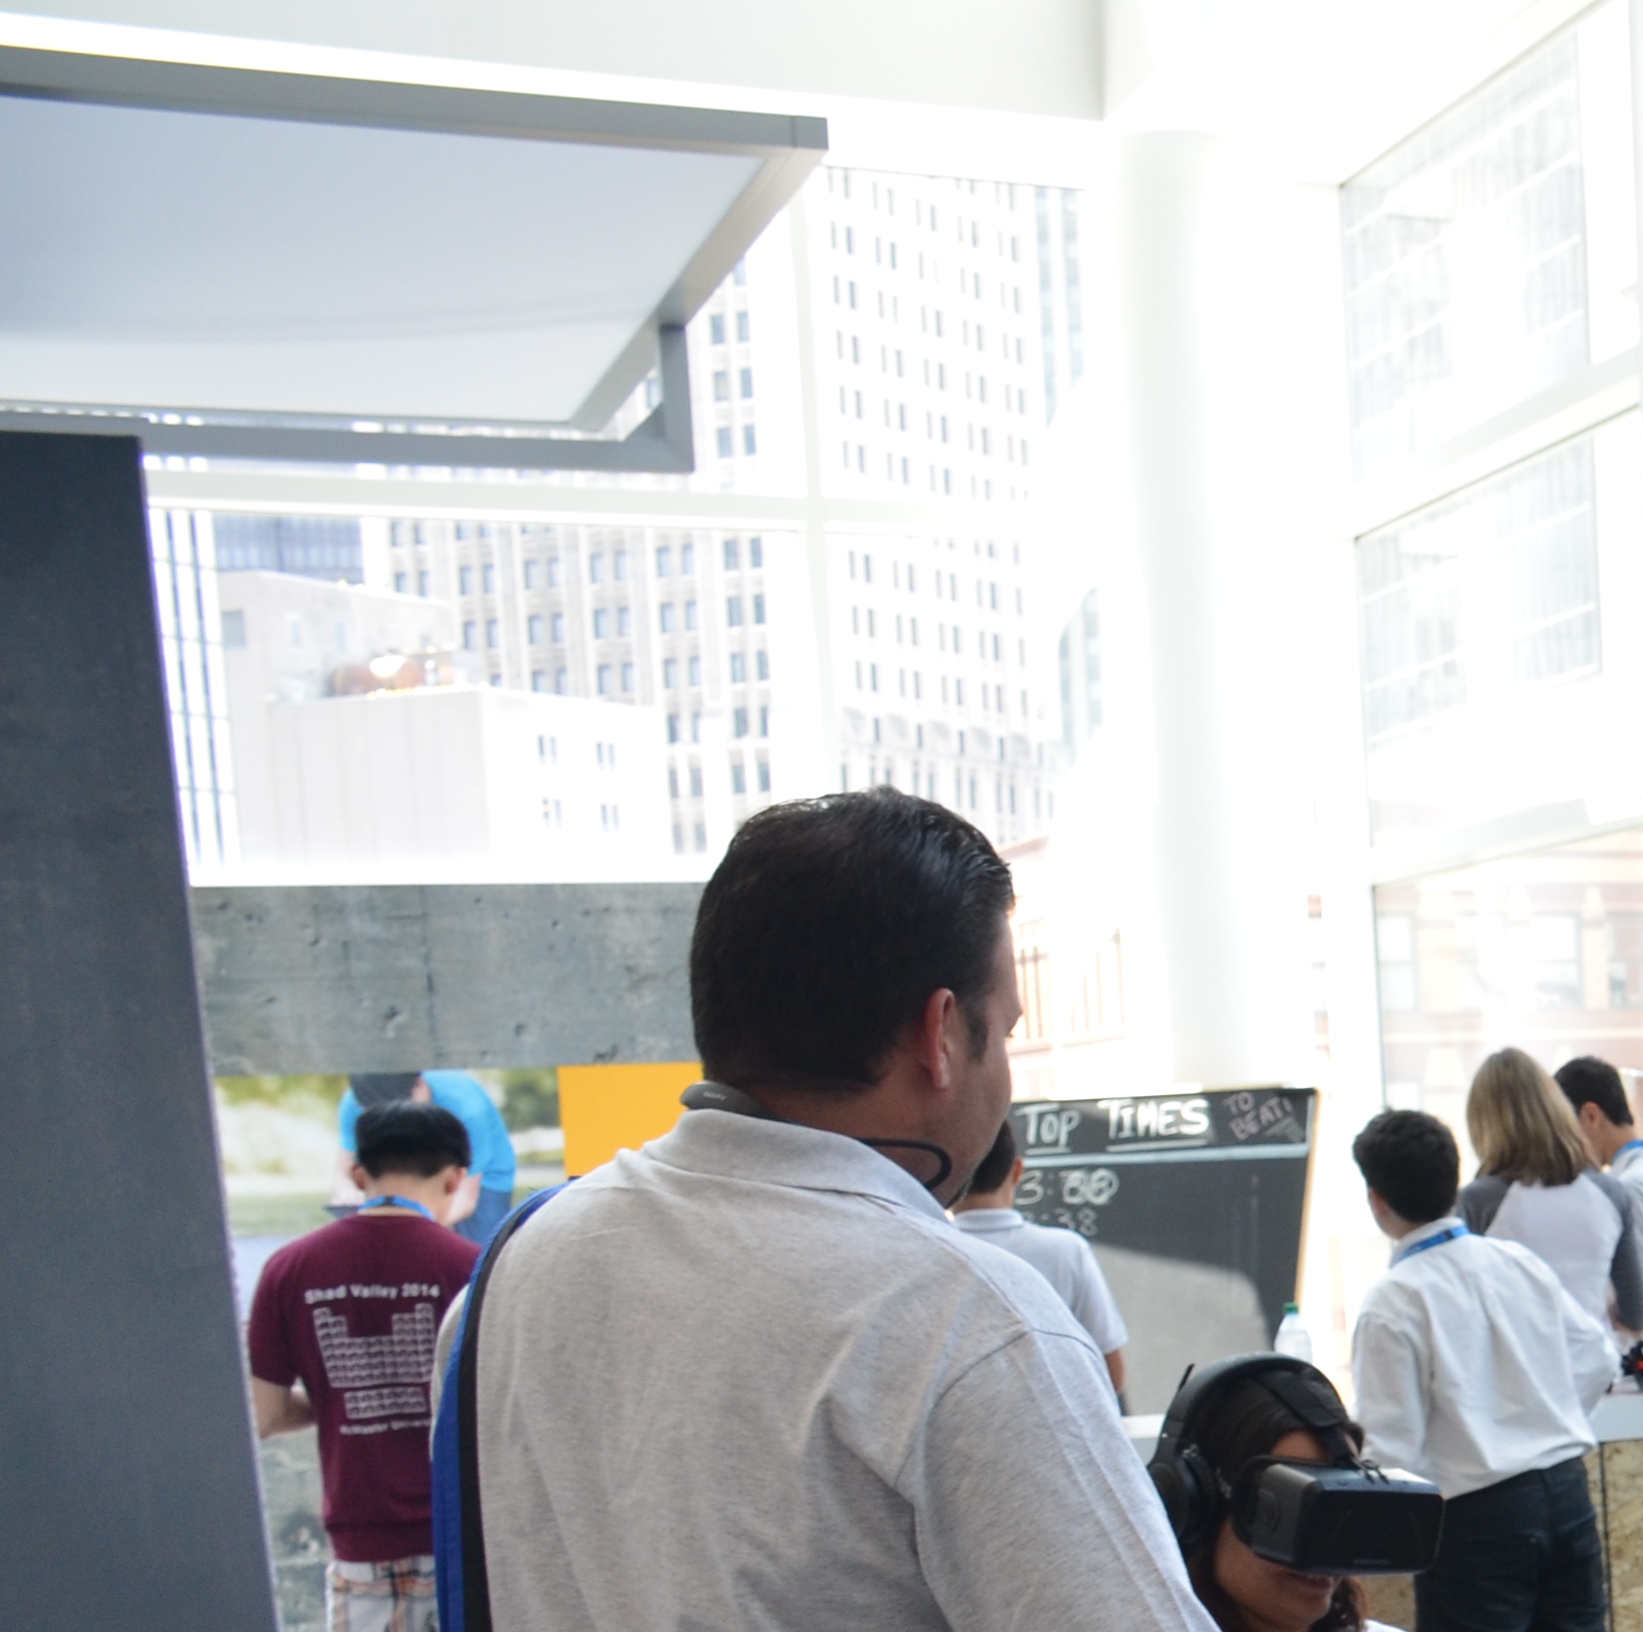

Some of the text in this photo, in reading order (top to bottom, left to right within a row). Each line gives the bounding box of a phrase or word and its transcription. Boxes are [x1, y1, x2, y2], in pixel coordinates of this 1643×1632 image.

[1097, 1098, 1210, 1139] TIMES
[304, 1284, 347, 1304] Shad
[349, 1283, 398, 1299] Valley
